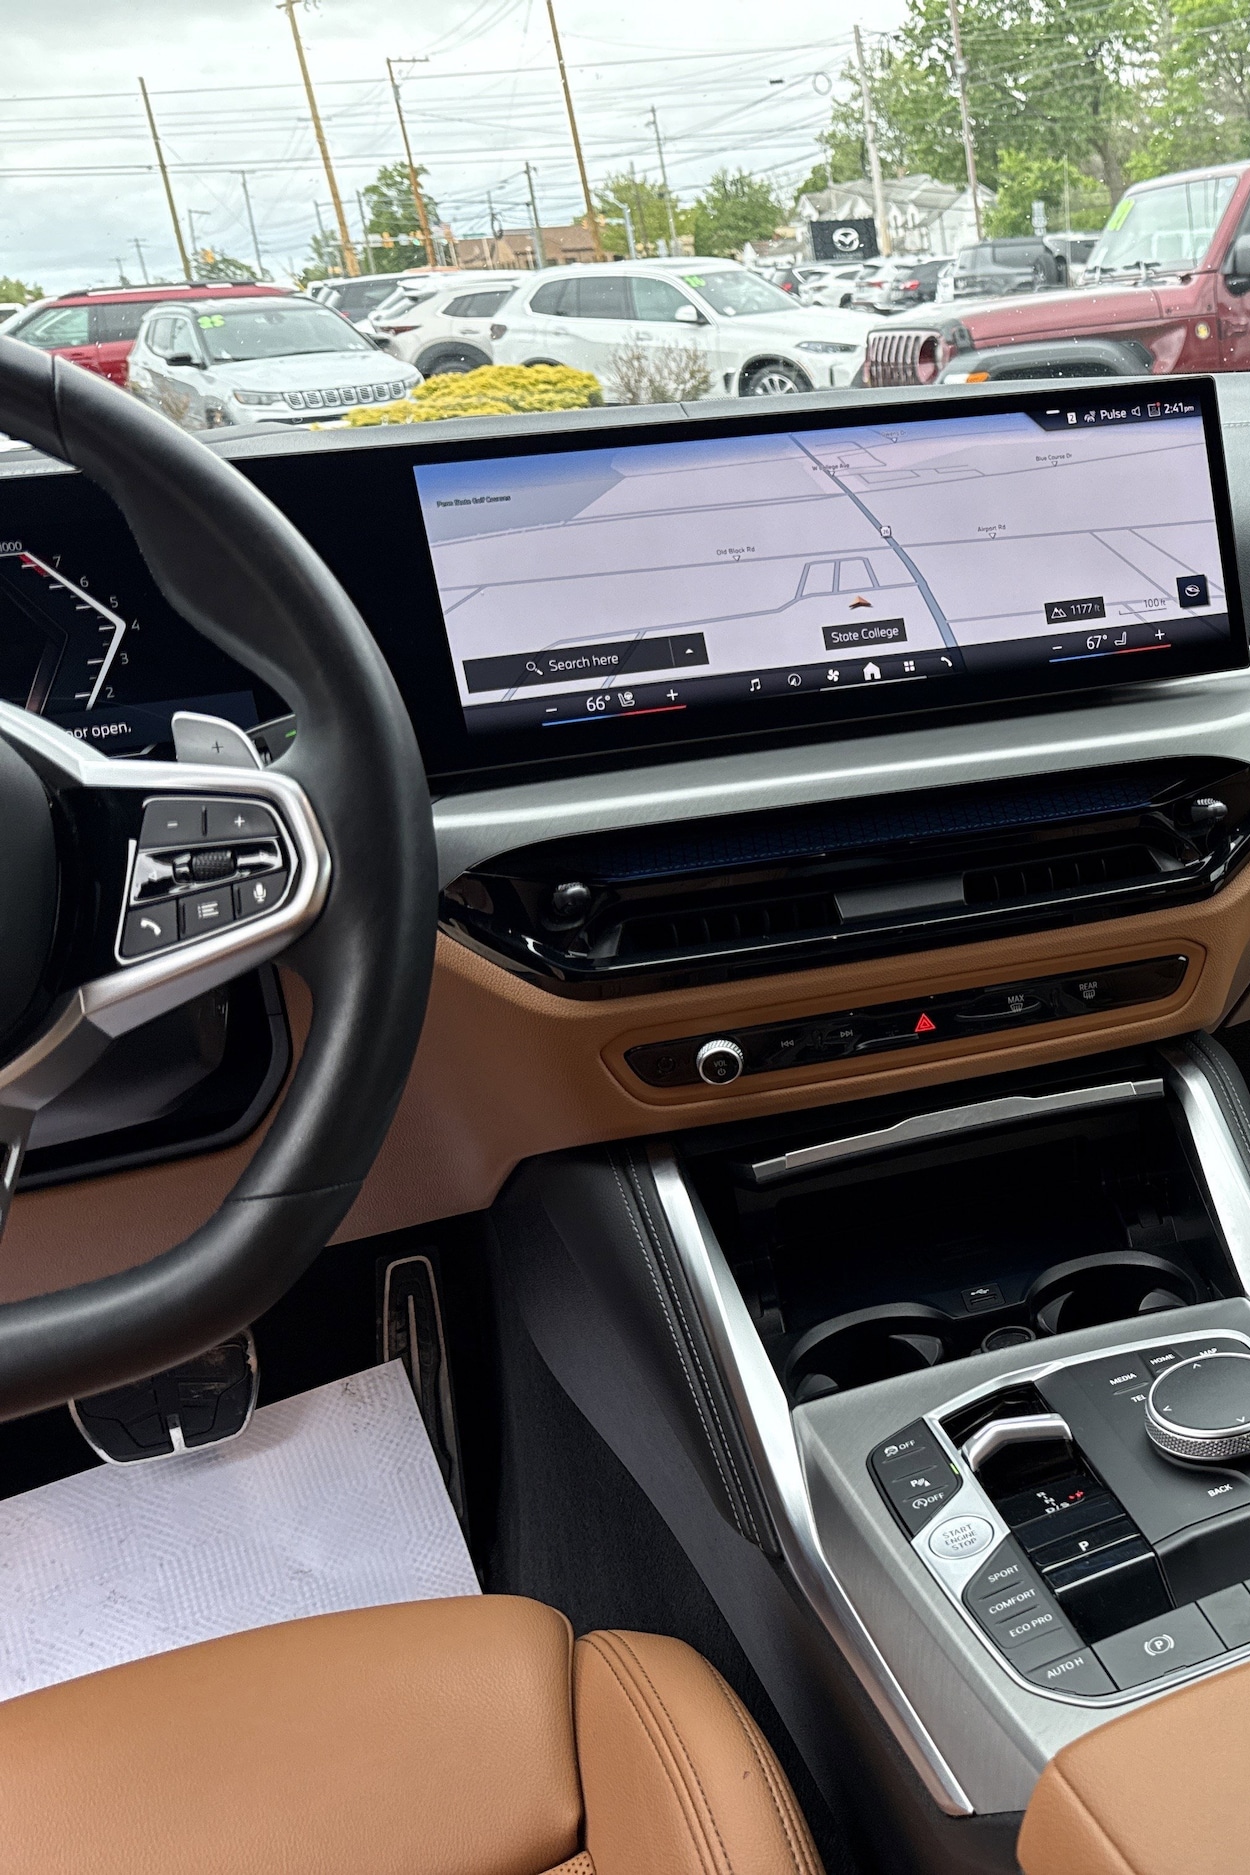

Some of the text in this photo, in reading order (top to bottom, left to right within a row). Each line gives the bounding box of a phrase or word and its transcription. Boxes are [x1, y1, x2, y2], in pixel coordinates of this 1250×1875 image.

[1100, 410, 1127, 420] Pulse
[53, 555, 61, 568] 7
[79, 576, 89, 588] 6
[109, 596, 119, 608] 5
[1143, 598, 1160, 608] 100
[1070, 603, 1093, 615] 1177
[131, 619, 140, 631] 4
[831, 627, 899, 643] State College
[1086, 634, 1108, 649] 67°
[120, 652, 129, 664] 3
[549, 655, 619, 672] Search here
[106, 686, 115, 699] 2
[586, 695, 611, 712] 66°
[1079, 981, 1098, 991] REAR
[1007, 994, 1024, 1004] MAX
[1200, 1347, 1218, 1356] MAP
[1150, 1354, 1175, 1366] HOME
[1109, 1373, 1137, 1385] MEDIA
[1131, 1394, 1146, 1403] TEL
[898, 1440, 915, 1451] OFF
[1207, 1483, 1233, 1498] BACK
[927, 1492, 945, 1504] OFF
[942, 1523, 972, 1539] START
[945, 1530, 977, 1546] ENGINE
[951, 1537, 977, 1551] STOP
[1078, 1540, 1089, 1552] P
[987, 1564, 1019, 1583] SPORT
[988, 1588, 1036, 1614] COMFORT
[1009, 1613, 1053, 1638] ECO PRO
[1047, 1656, 1084, 1679] AUTO H
